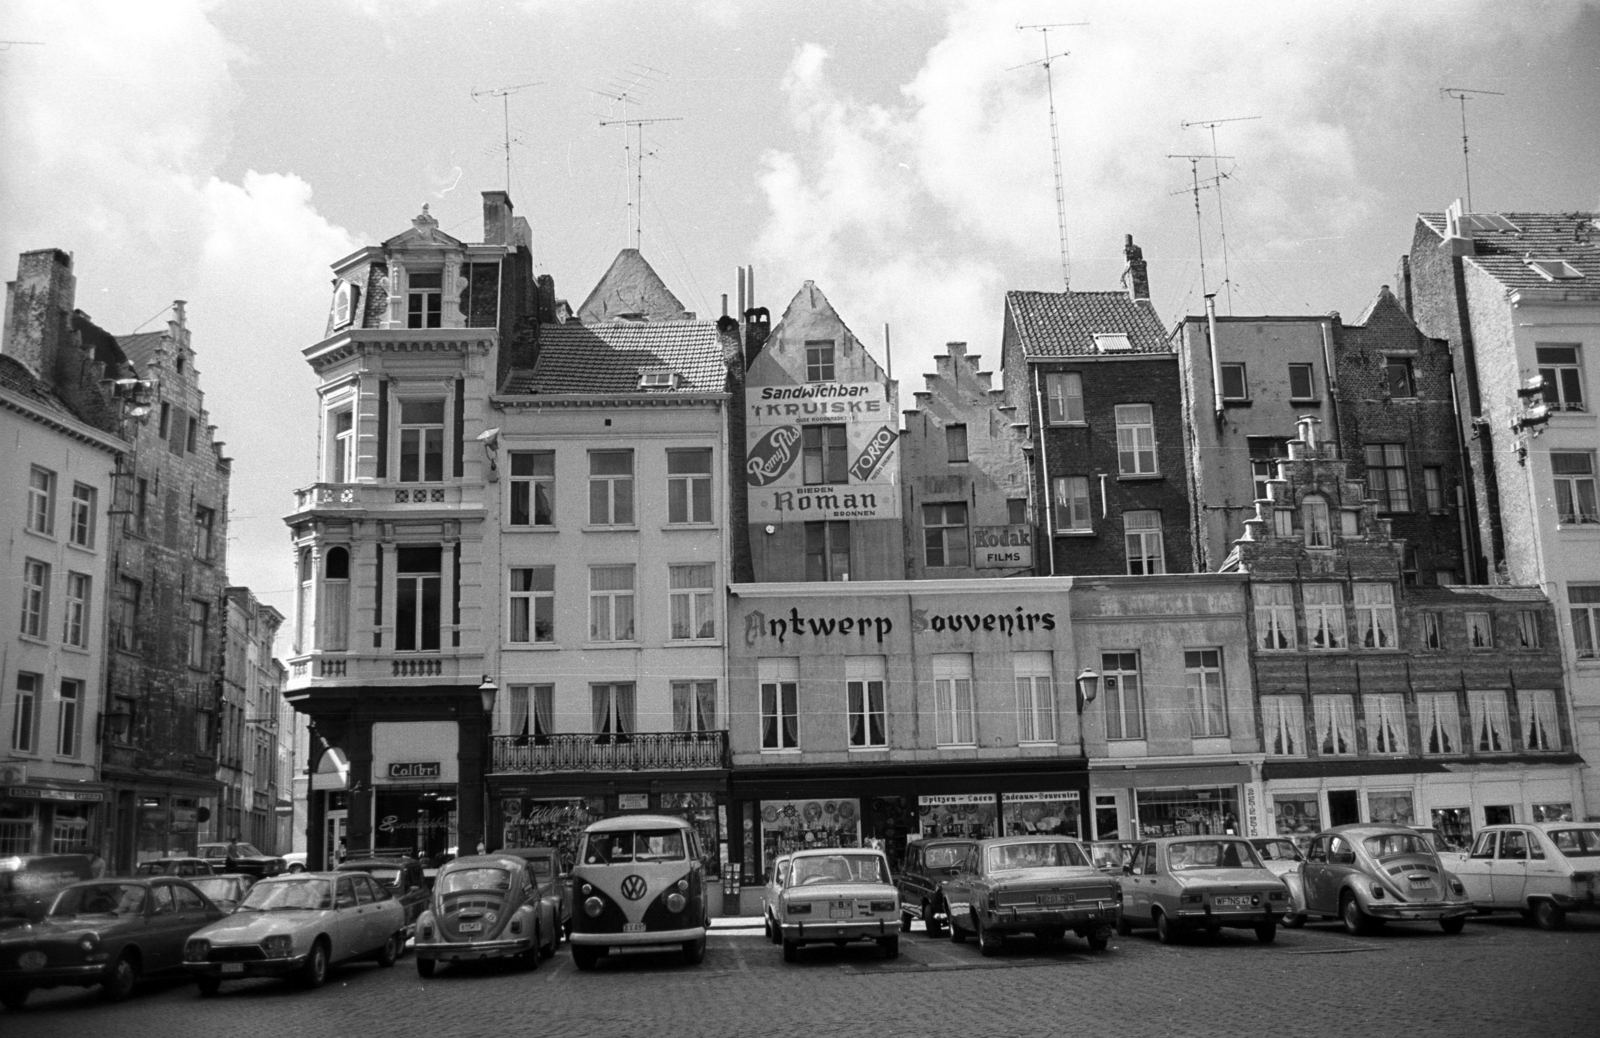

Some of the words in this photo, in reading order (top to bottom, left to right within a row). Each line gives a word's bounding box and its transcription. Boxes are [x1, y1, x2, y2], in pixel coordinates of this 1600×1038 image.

[761, 385, 869, 400] Sandwichbar
[767, 401, 880, 416] KRUISKE
[747, 450, 784, 485] Romy
[770, 427, 800, 463] Pils
[850, 431, 890, 479] TORRO
[773, 491, 877, 511] Roman
[975, 529, 1031, 547] Kodak
[987, 553, 1020, 561] FILMS
[745, 607, 892, 646] Antwerp
[912, 606, 1055, 637] Souvenirs
[391, 764, 438, 776] Colibri
[838, 901, 844, 909] B
